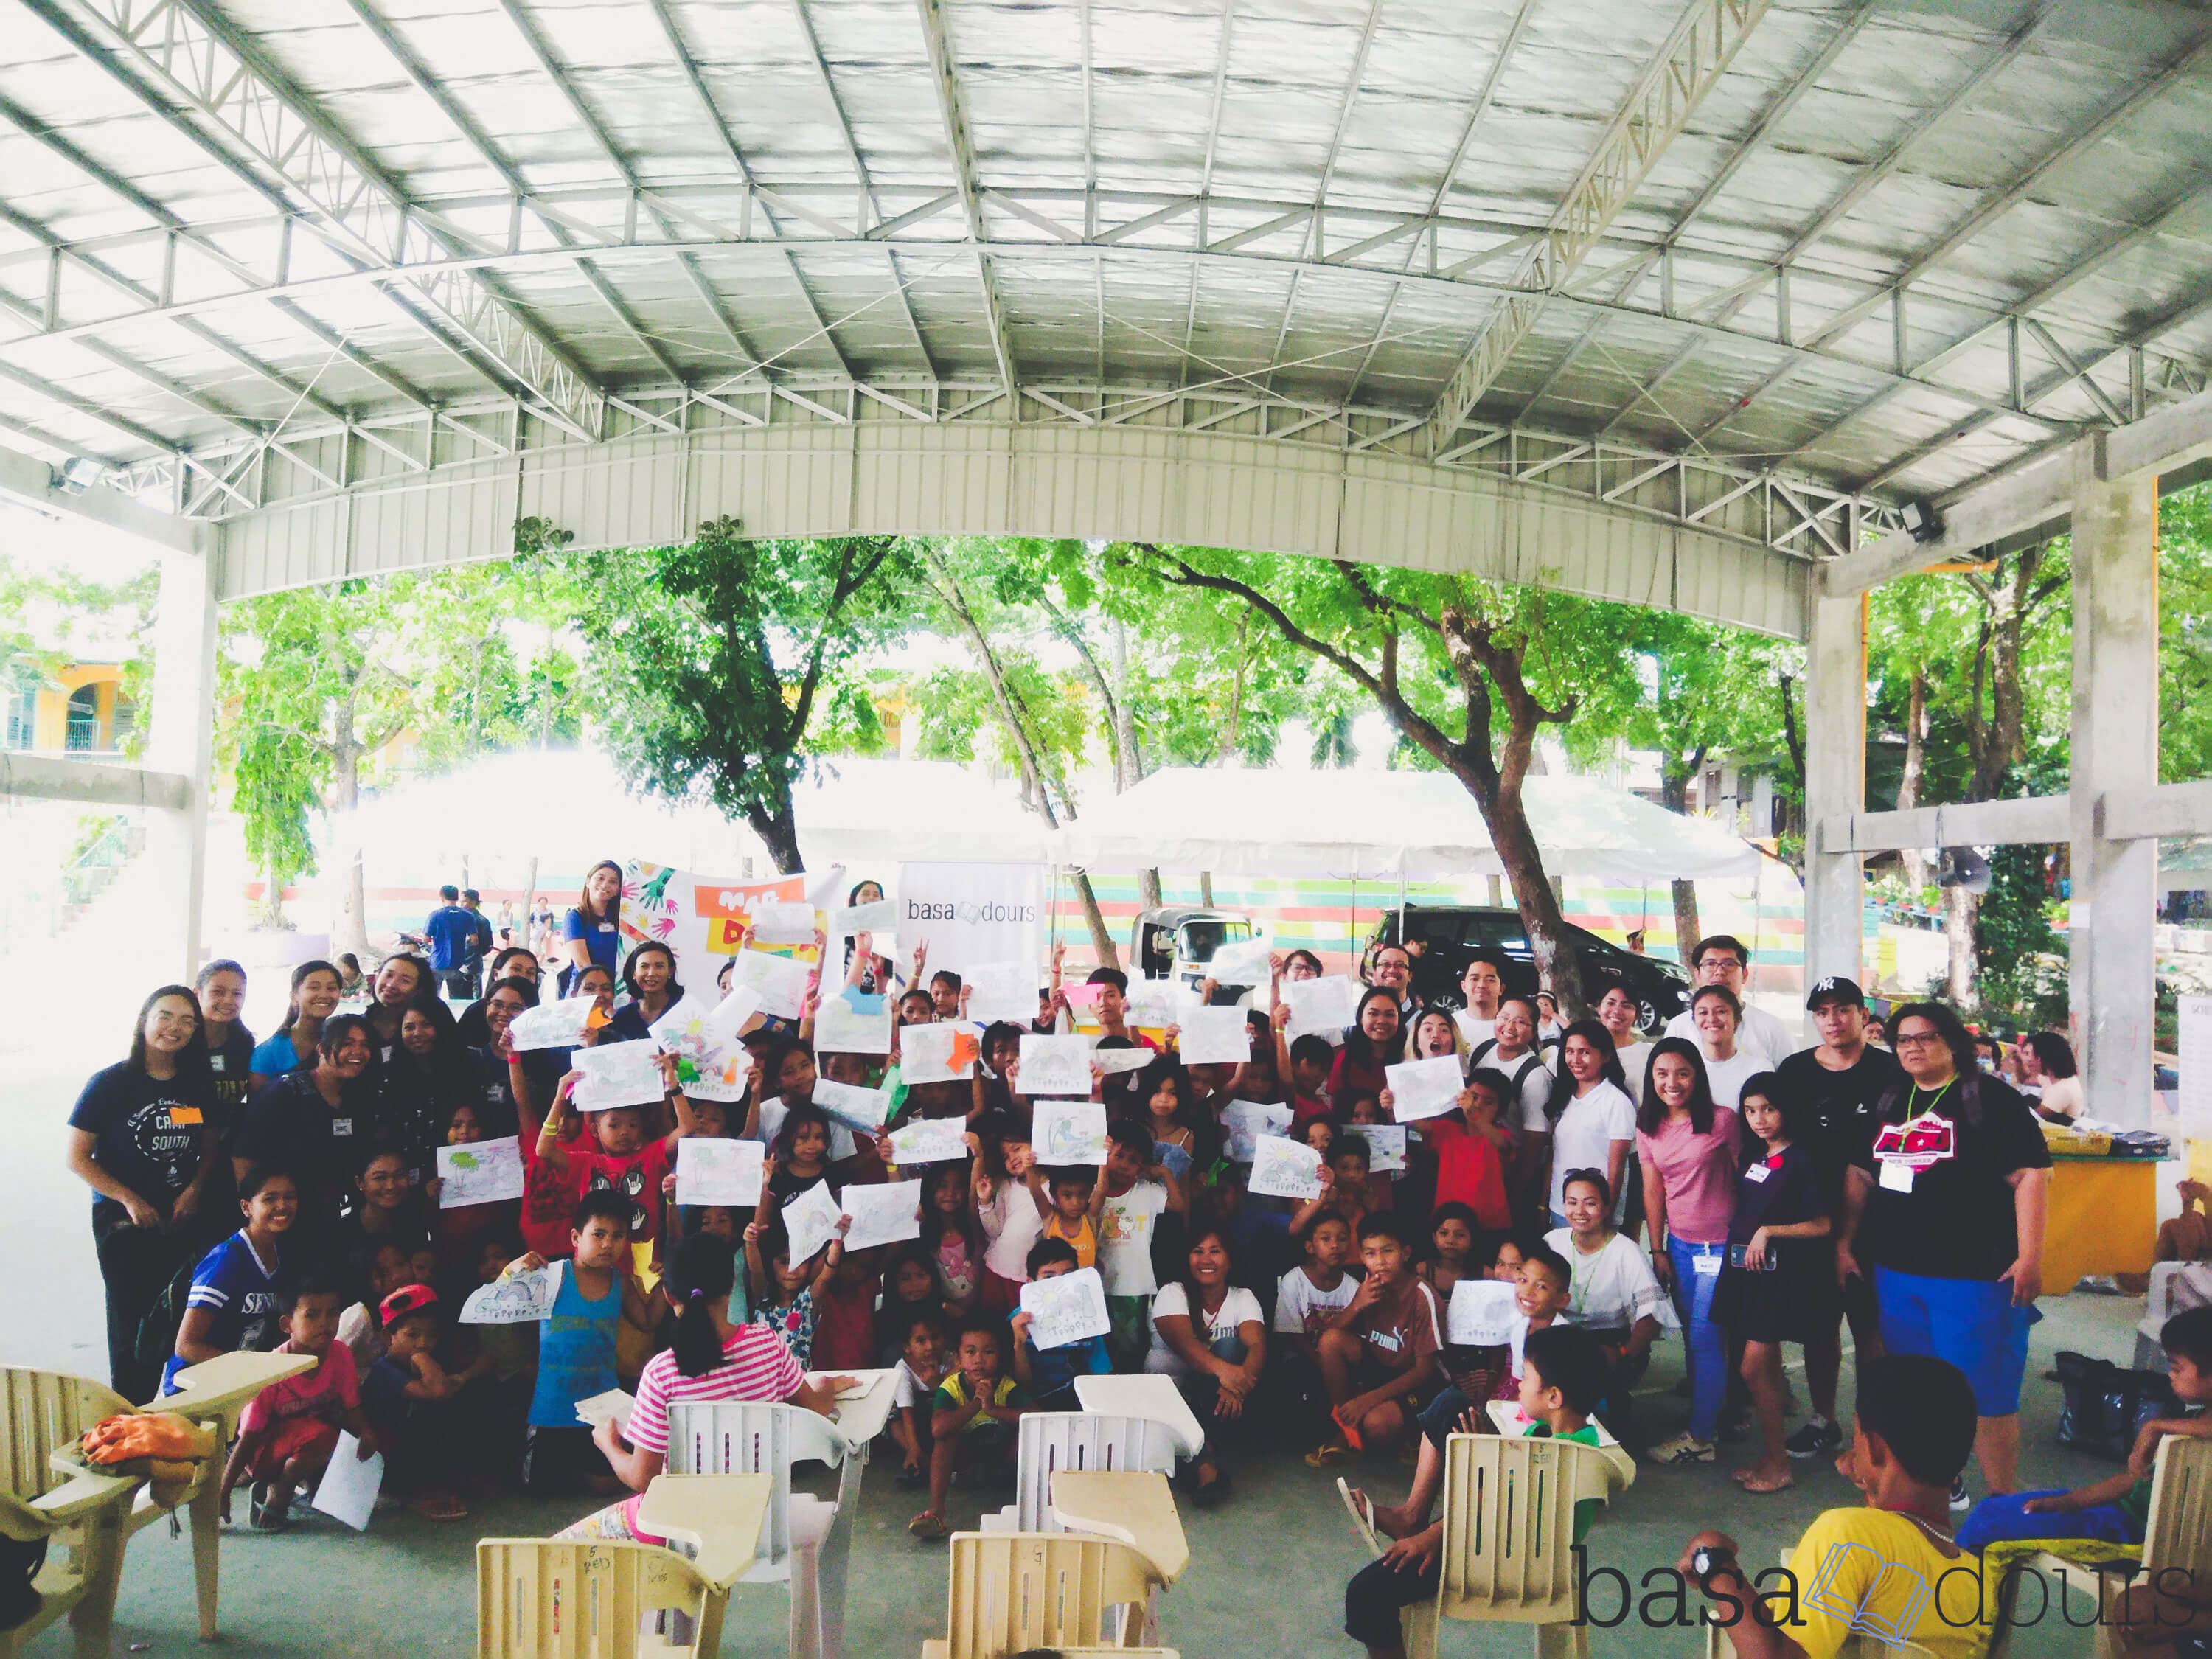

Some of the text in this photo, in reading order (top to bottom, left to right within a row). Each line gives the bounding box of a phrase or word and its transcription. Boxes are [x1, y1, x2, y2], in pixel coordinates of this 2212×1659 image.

[908, 899, 1035, 922] basa dours
[152, 1135, 190, 1150] SOUTH
[1369, 1330, 1399, 1352] PUMA
